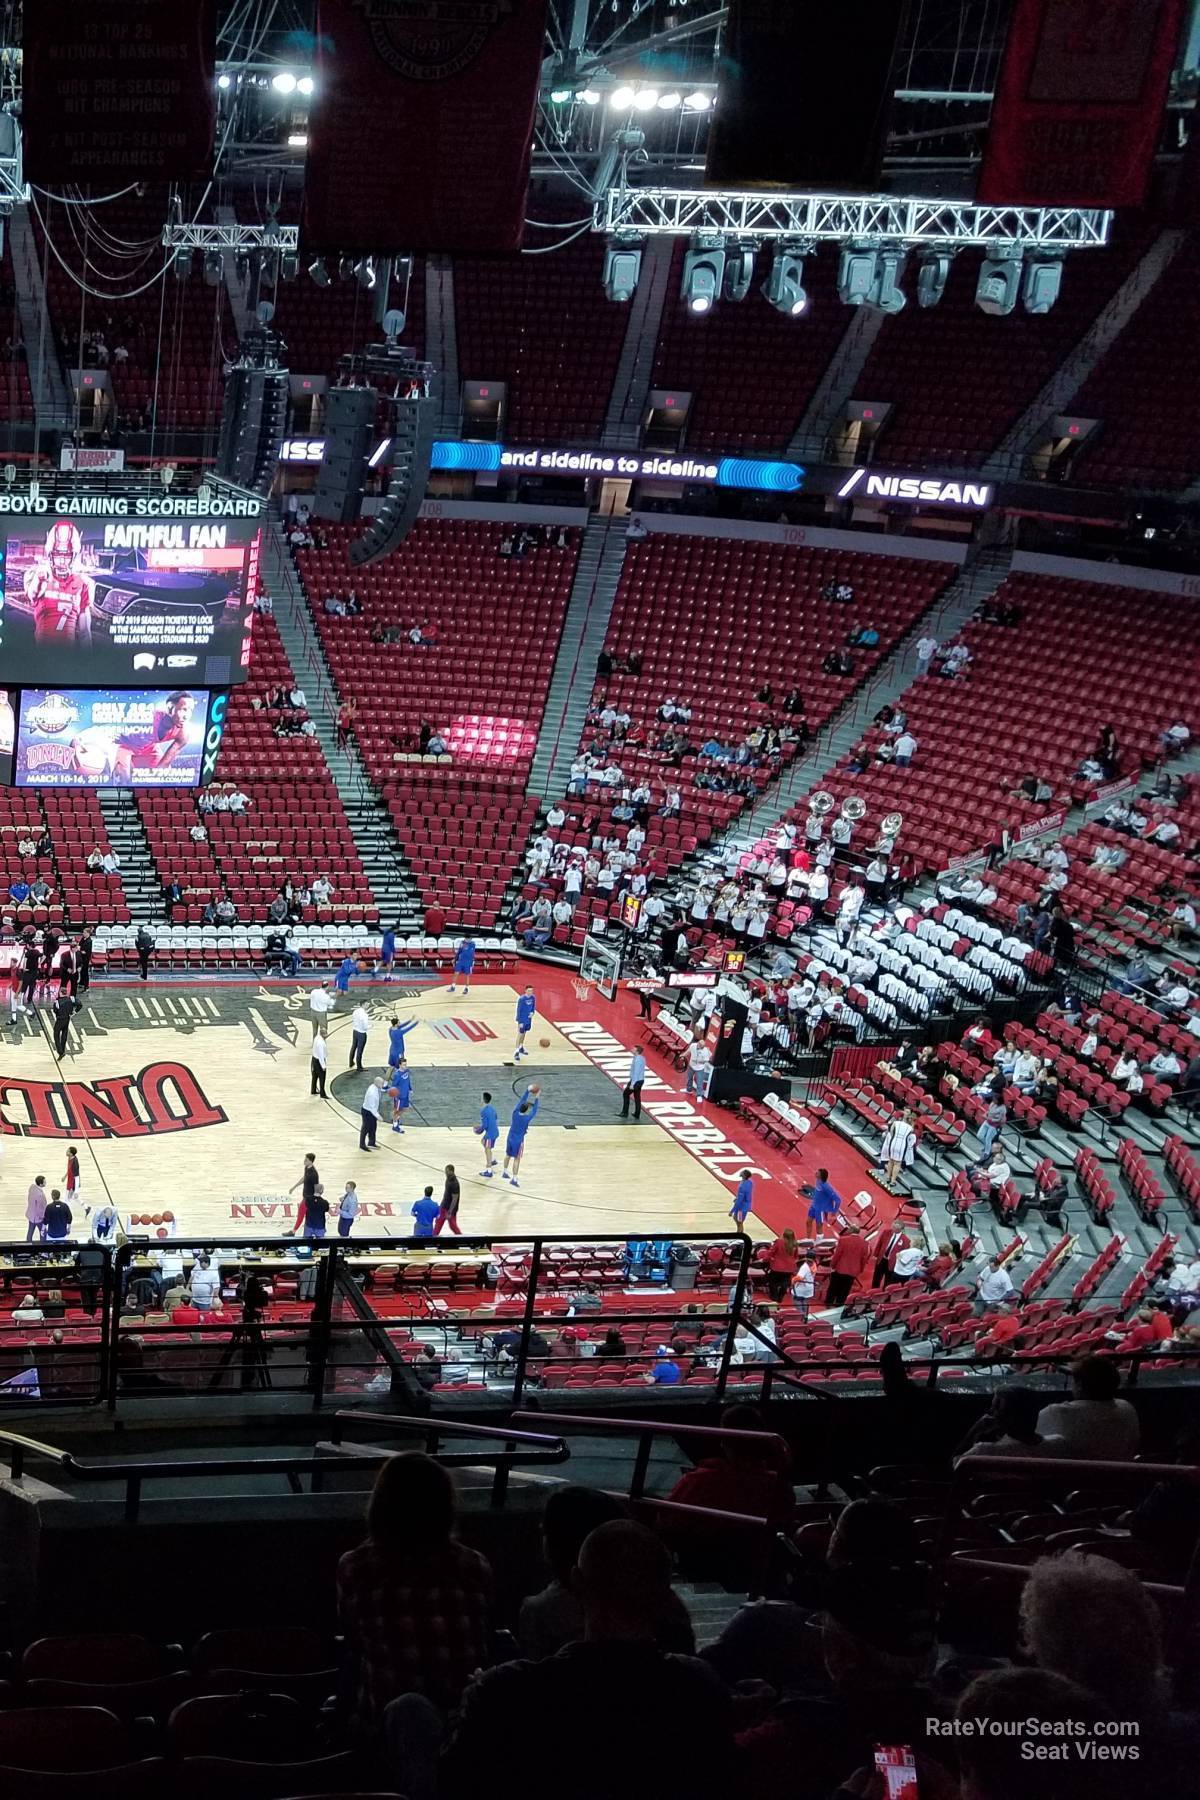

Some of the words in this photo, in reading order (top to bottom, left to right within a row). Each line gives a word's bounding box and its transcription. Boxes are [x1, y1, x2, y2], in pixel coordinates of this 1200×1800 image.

[500, 450, 538, 467] and
[540, 451, 614, 471] sideline
[617, 456, 638, 472] to
[642, 458, 718, 478] sideline
[866, 475, 989, 506] NISSAN
[55, 498, 129, 515] GAMING
[135, 499, 260, 516] SCOREBOARD
[422, 503, 442, 515] 108
[104, 524, 185, 548] FAITHFUL
[189, 524, 227, 548] FAN
[782, 528, 806, 542] 109
[203, 695, 226, 775] COX
[26, 743, 76, 771] UNLV
[26, 774, 58, 783] MARCH
[60, 774, 86, 784] 10-16,
[87, 774, 110, 783] 2019
[641, 1101, 772, 1182] REBELS
